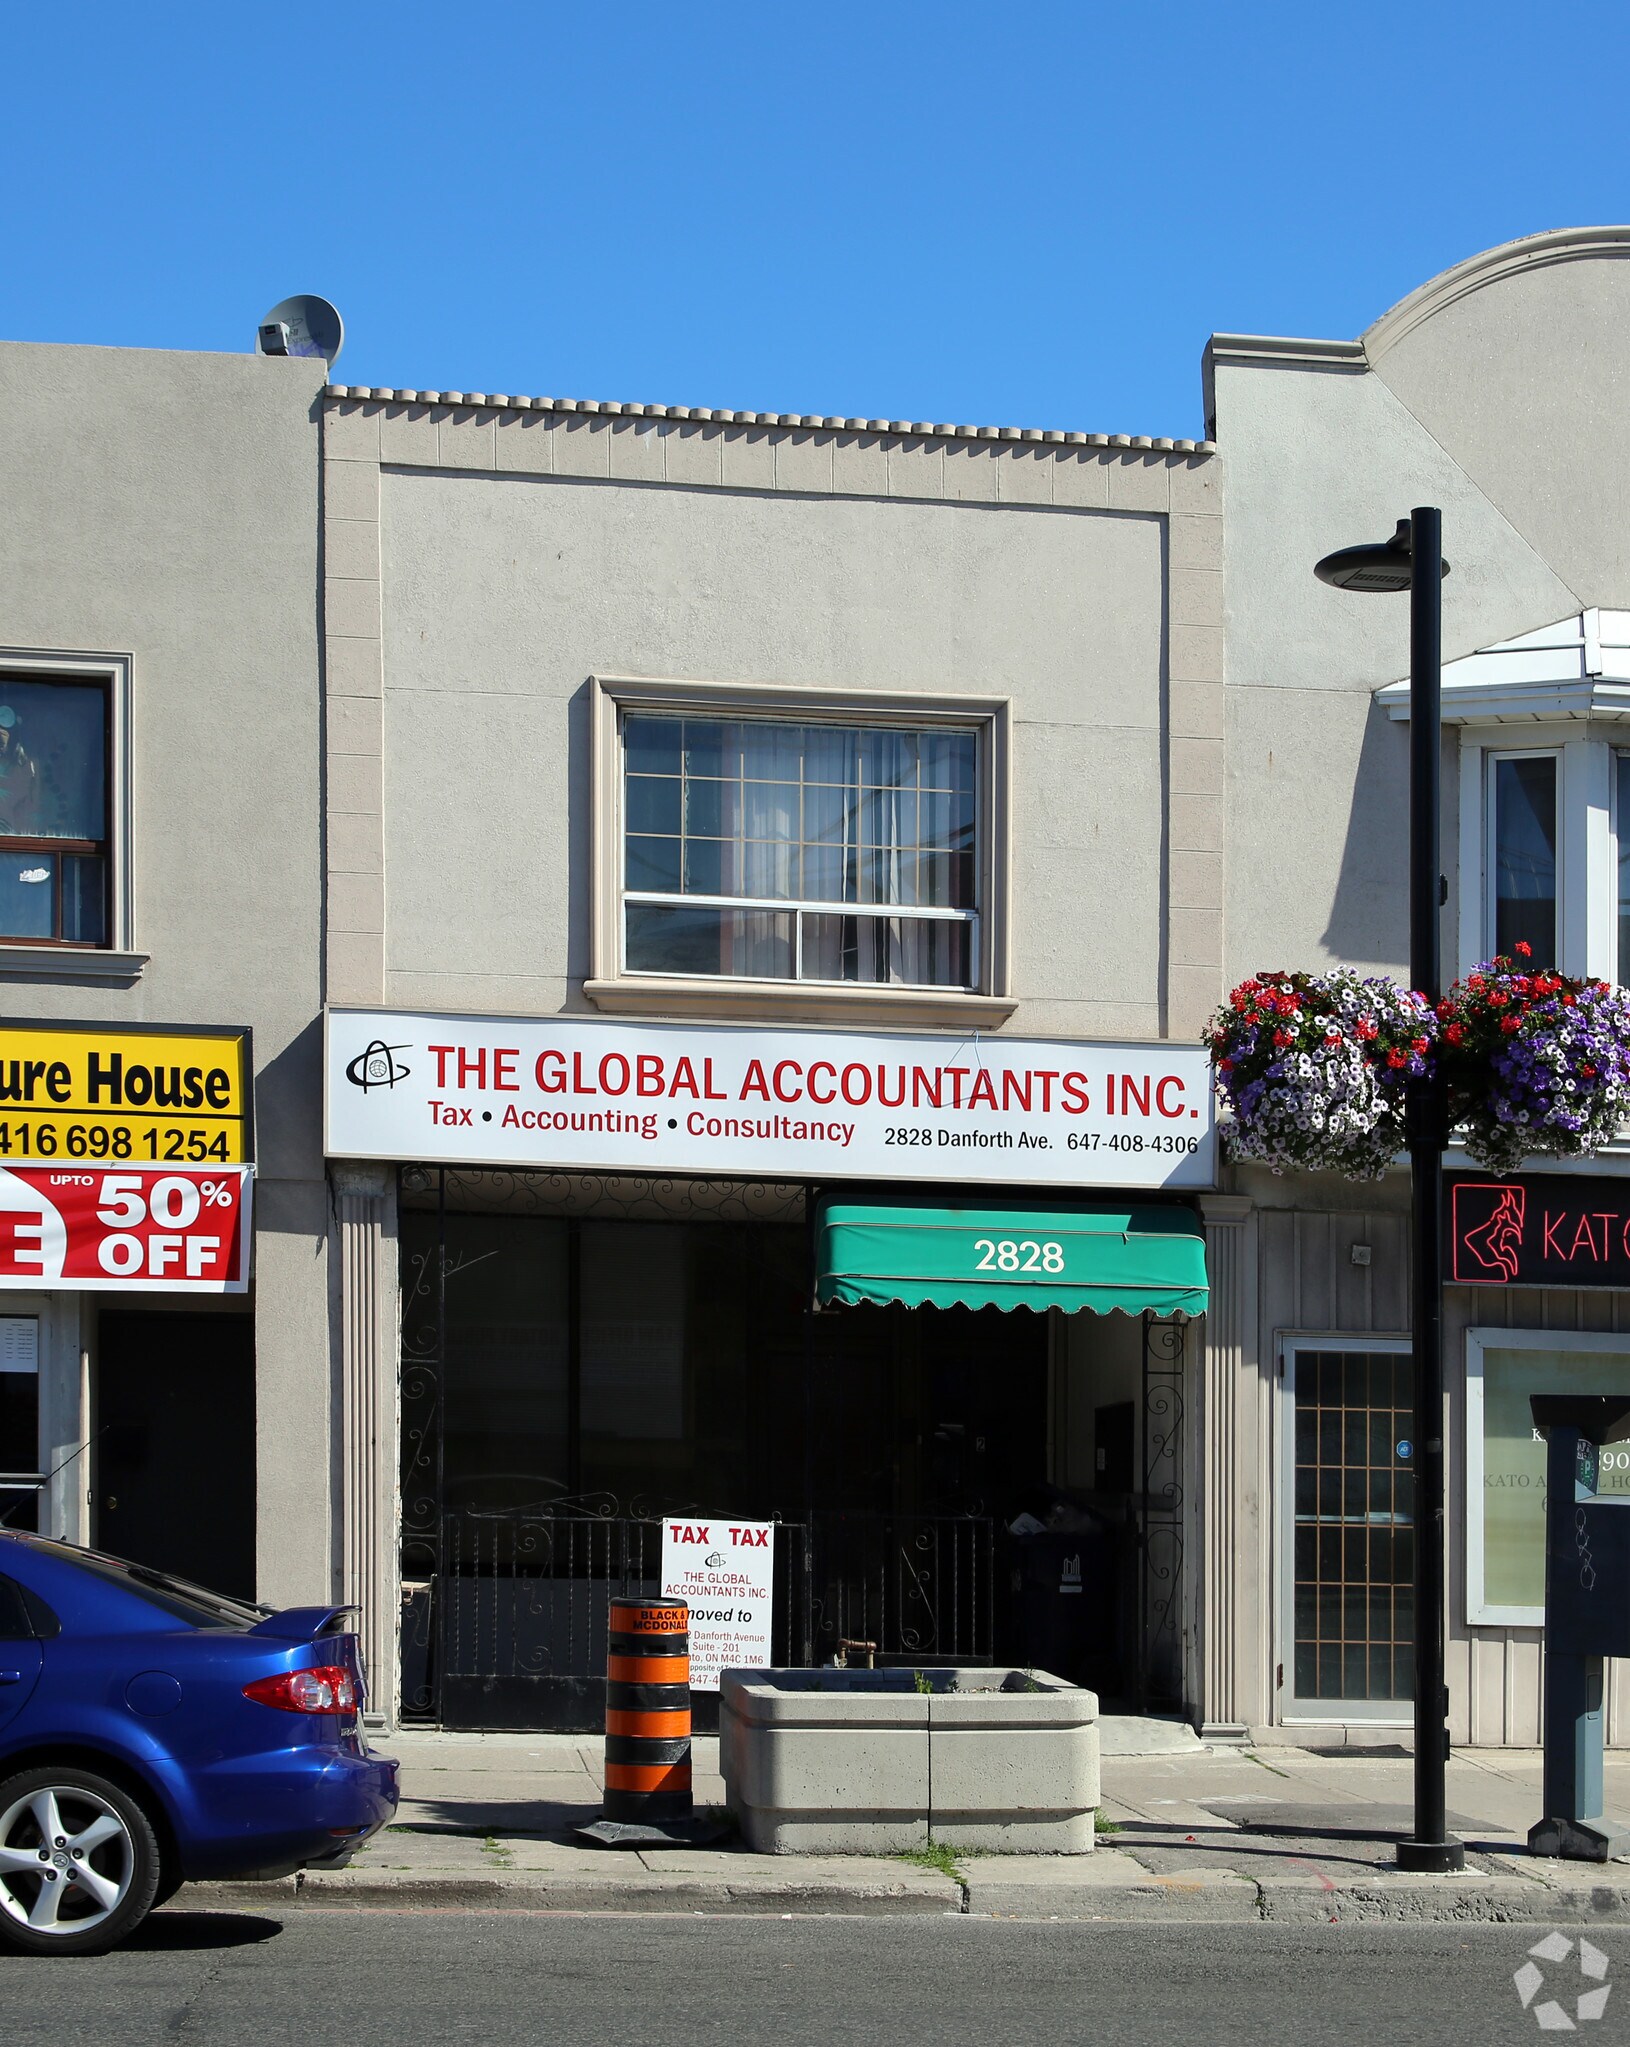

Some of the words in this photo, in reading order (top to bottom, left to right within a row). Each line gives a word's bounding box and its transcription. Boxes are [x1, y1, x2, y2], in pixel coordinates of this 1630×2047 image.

[87, 1052, 231, 1109] House
[428, 1045, 520, 1091] THE
[535, 1050, 727, 1100] GLOBAL
[739, 1059, 1090, 1114] ACCOUNTANTS
[1106, 1073, 1199, 1118] INC.
[428, 1101, 473, 1127] Tax
[502, 1104, 658, 1139] Accounting
[686, 1111, 856, 1147] Consultancy
[66, 1124, 132, 1159] 698
[142, 1128, 230, 1162] 1254
[885, 1128, 933, 1146] 2828
[938, 1130, 1013, 1149] Danforth
[1018, 1132, 1054, 1150] Ave.
[1067, 1133, 1199, 1154] 647-408-4306
[50, 1175, 94, 1187] UPTO
[96, 1175, 233, 1229] 50%
[1544, 1210, 1630, 1261] KAT
[98, 1233, 220, 1277] OFF
[974, 1240, 1065, 1273] 2828
[1599, 1452, 1630, 1472] 90
[1483, 1474, 1530, 1488] KATO
[670, 1525, 710, 1545] TAX
[728, 1528, 769, 1547] TAX
[684, 1572, 705, 1583] THE
[707, 1572, 752, 1585] GLOBAL
[665, 1584, 746, 1598] ACCOUNTANTS
[748, 1588, 769, 1599] INC.
[641, 1611, 678, 1620] BLACK
[737, 1609, 752, 1623] to
[692, 1641, 715, 1652] Suite
[722, 1642, 740, 1653] 201
[694, 1630, 732, 1641] Danforth
[733, 1632, 766, 1643] Avenue
[705, 1653, 719, 1662] ON
[720, 1653, 742, 1663] M4C
[744, 1655, 764, 1665] 1M6
